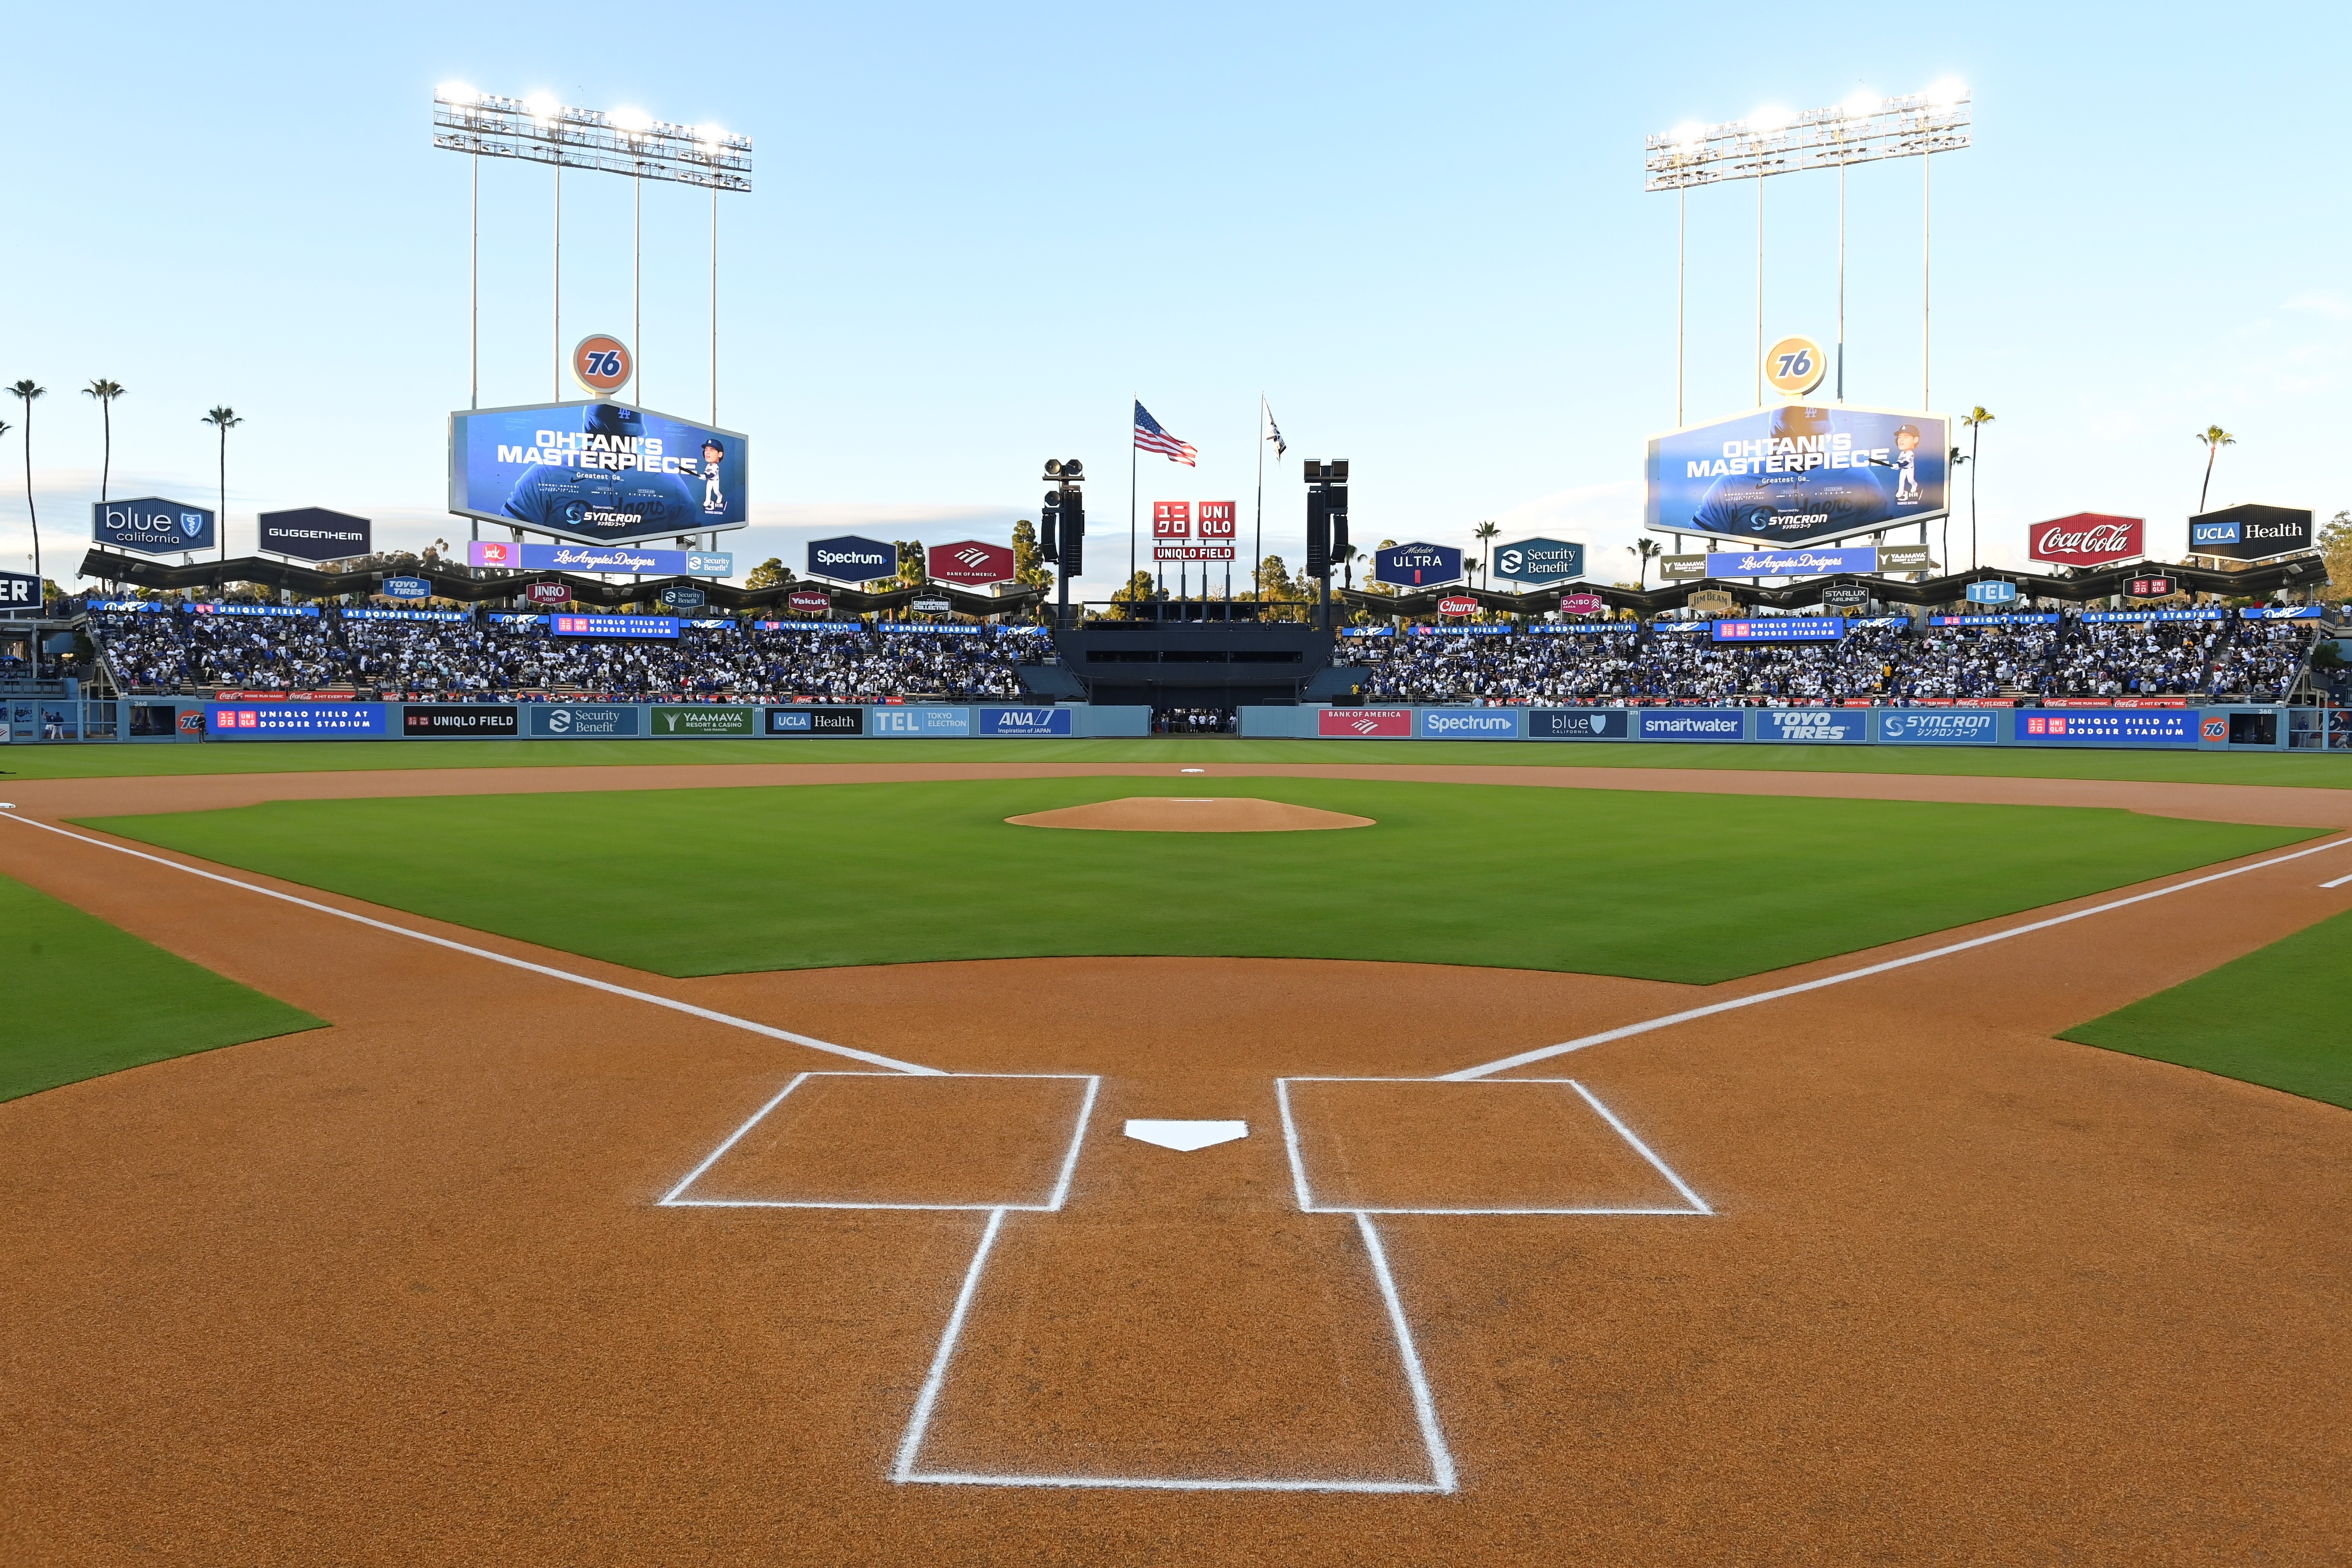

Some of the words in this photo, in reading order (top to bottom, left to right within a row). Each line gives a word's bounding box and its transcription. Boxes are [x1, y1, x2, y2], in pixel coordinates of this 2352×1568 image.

[585, 349, 622, 378] 76
[1775, 348, 1813, 379] 76
[536, 430, 663, 455] OHTANI'S
[1723, 433, 1851, 458] OHTANI'S
[498, 445, 697, 474] MASTERPIECE
[1687, 448, 1889, 478] MASTERPIECE
[583, 512, 641, 523] SYNCRON
[1159, 506, 1185, 518] ユニ
[1203, 506, 1228, 518] UNI
[106, 506, 172, 532] blue
[1768, 514, 1827, 525] SYNCRON
[1158, 520, 1185, 533] クロ
[1203, 520, 1230, 535] QLO
[2197, 527, 2235, 540] UCLA
[2245, 523, 2303, 539] Health
[116, 532, 179, 544] california
[269, 528, 362, 541] GUGGENHEIM
[2038, 523, 2134, 555] Coca-Cola
[483, 545, 505, 559] Jack
[1157, 548, 1196, 560] UNIQLO
[1200, 548, 1231, 558] FIELD
[1401, 546, 1435, 555] Michelob
[1527, 548, 1576, 562] Security
[553, 550, 572, 563] Los
[572, 550, 613, 569] Angeles
[612, 552, 655, 571] Dodgers
[703, 557, 730, 566] Security
[817, 550, 882, 566] Spectrum
[1394, 555, 1442, 567] ULTRA
[1738, 555, 1757, 570] Los
[1756, 555, 1798, 573] Angeles
[1797, 553, 1842, 572] Dodgers
[1528, 561, 1569, 573] Benefit
[389, 580, 418, 588] TOYO
[393, 588, 425, 596] TIRES
[534, 585, 565, 599] JINRO
[1971, 584, 2009, 600] TEL
[791, 597, 828, 605] Yakult
[1439, 600, 1475, 612] Churu
[1691, 593, 1706, 608] JIM
[1707, 591, 1728, 606] BEAM
[365, 611, 408, 619] DODGER
[2163, 610, 2216, 620] STADIUM
[2114, 700, 2139, 708] Coca-Cola
[180, 715, 200, 729] 76
[433, 716, 476, 727] UNIQLO
[480, 716, 513, 726] FIELD
[575, 710, 620, 723] Security
[683, 712, 743, 721] YAAMAVA'
[779, 716, 806, 726] UCLA
[814, 716, 855, 727] Health
[876, 712, 919, 731] TEL
[998, 712, 1033, 725] ANA
[1552, 715, 1588, 729] blue
[1772, 712, 1831, 726] TOYO
[1906, 716, 1990, 728] SYNCRON
[576, 721, 614, 732] Benefit
[1428, 714, 1506, 733] Spectrum
[1645, 718, 1738, 732] smartwater
[2202, 721, 2225, 737] 76
[1780, 726, 1846, 740] TIRES
[1917, 727, 1978, 737] シンクロンコーワ
